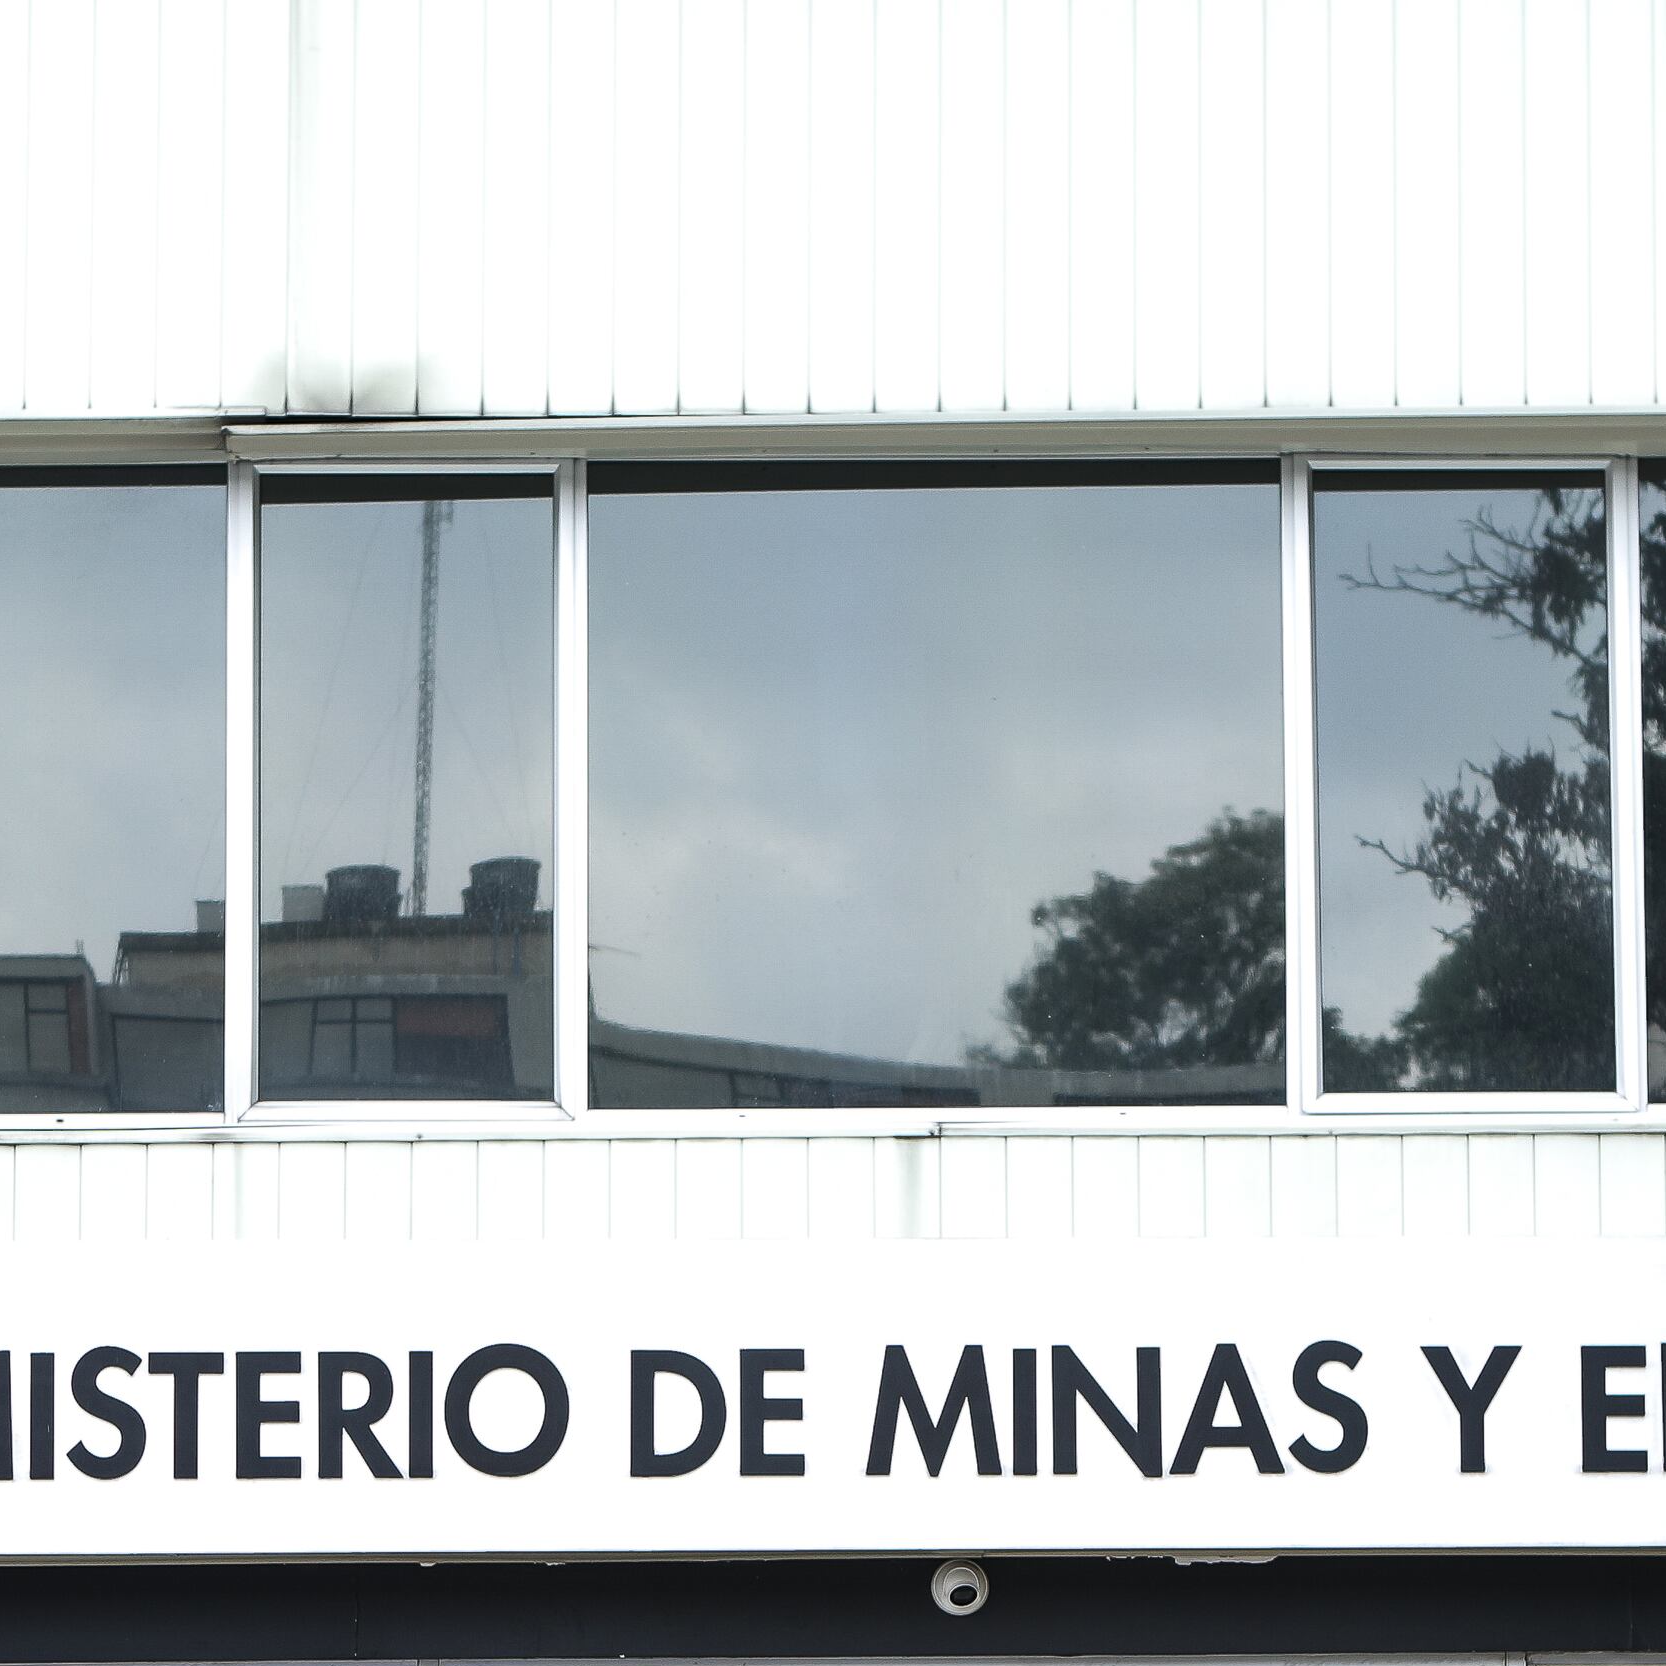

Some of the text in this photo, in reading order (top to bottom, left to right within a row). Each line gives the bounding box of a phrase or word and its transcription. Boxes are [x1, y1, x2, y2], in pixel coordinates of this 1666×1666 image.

[630, 1349, 805, 1477] DE
[866, 1341, 1368, 1477] MINAS
[1421, 1346, 1521, 1473] Y
